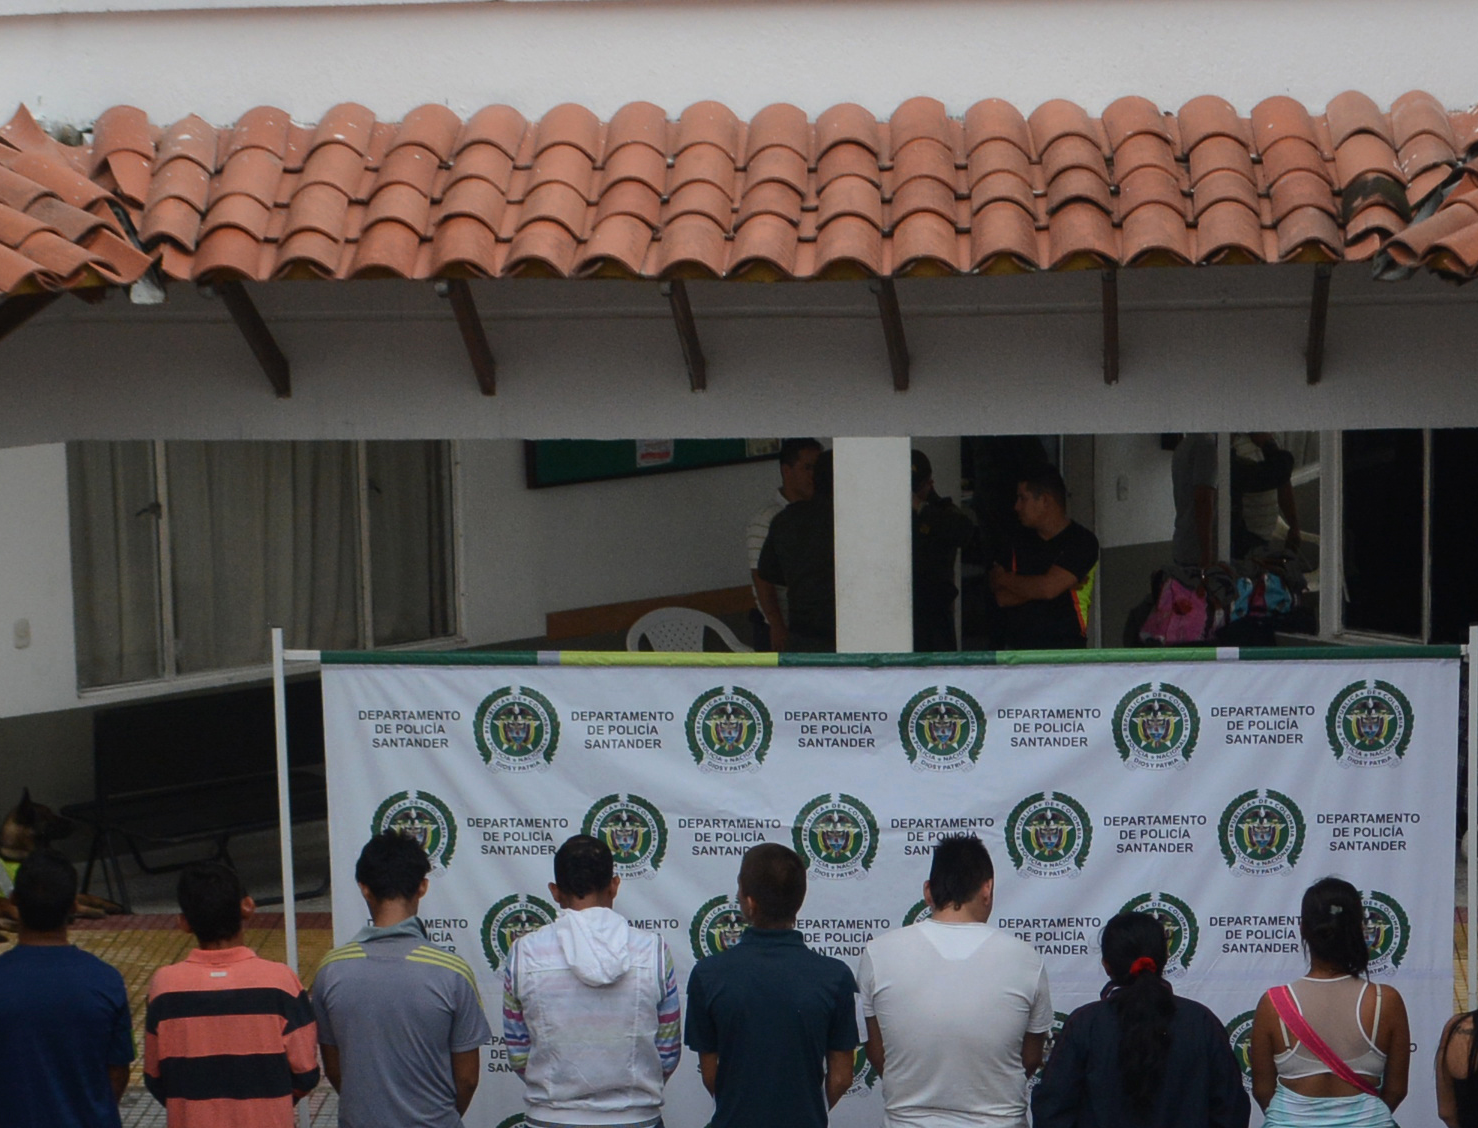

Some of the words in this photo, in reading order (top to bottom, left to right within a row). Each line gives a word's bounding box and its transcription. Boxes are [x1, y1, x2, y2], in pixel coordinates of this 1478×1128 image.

[358, 710, 460, 721] DEPARTAMENTO
[571, 711, 674, 723] DEPARTAMENTO
[784, 711, 888, 723] DEPARTAMENTO
[997, 708, 1101, 720] DEPARTAMENTO
[1211, 705, 1315, 718] DEPARTAMENTO
[375, 724, 392, 735] DE
[396, 722, 445, 735] POLICÍA
[587, 725, 603, 736] DE
[607, 723, 658, 736] POLICÍA
[800, 725, 817, 736] DE
[821, 723, 872, 736] POLICÍA
[1013, 722, 1030, 735] DE
[1034, 721, 1085, 734] POLICÍA
[1227, 720, 1244, 731] DE
[1248, 718, 1299, 731] POLICÍA
[372, 738, 449, 749] SANTANDER
[584, 739, 662, 750] SANTANDER
[798, 738, 875, 749] SANTANDER
[1010, 736, 1088, 748] SANTANDER
[1225, 733, 1303, 745] SANTANDER
[467, 817, 569, 830] DEPARTAMENTO
[678, 818, 781, 830] DEPARTAMENTO
[891, 817, 994, 829] DEPARTAMENTO
[1104, 815, 1207, 827] DEPARTAMENTO
[1317, 813, 1420, 826] DEPARTAMENTO
[483, 832, 499, 843] DE
[503, 830, 553, 843] POLICÍA
[694, 832, 711, 843] DE
[715, 829, 766, 843] POLICÍA
[907, 831, 923, 843] DE
[1119, 829, 1136, 841] DE
[1140, 828, 1191, 841] POLICÍA
[1332, 827, 1349, 839] DE
[1353, 825, 1404, 839] POLICÍA
[481, 845, 557, 856] SANTANDER
[1116, 842, 1194, 854] SANTANDER
[1329, 840, 1406, 852] SANTANDER
[797, 919, 891, 930] EPARTAMENTO
[999, 917, 1101, 929] DEPARTAMENTO
[1209, 916, 1301, 927] DEPARTAMENT
[804, 933, 821, 944] DE
[825, 931, 874, 943] POLICÍA
[1035, 931, 1085, 943] POLICÍA
[1226, 930, 1242, 941] DE
[1246, 928, 1296, 941] POLICÍA
[1222, 942, 1299, 953] SANTANDER
